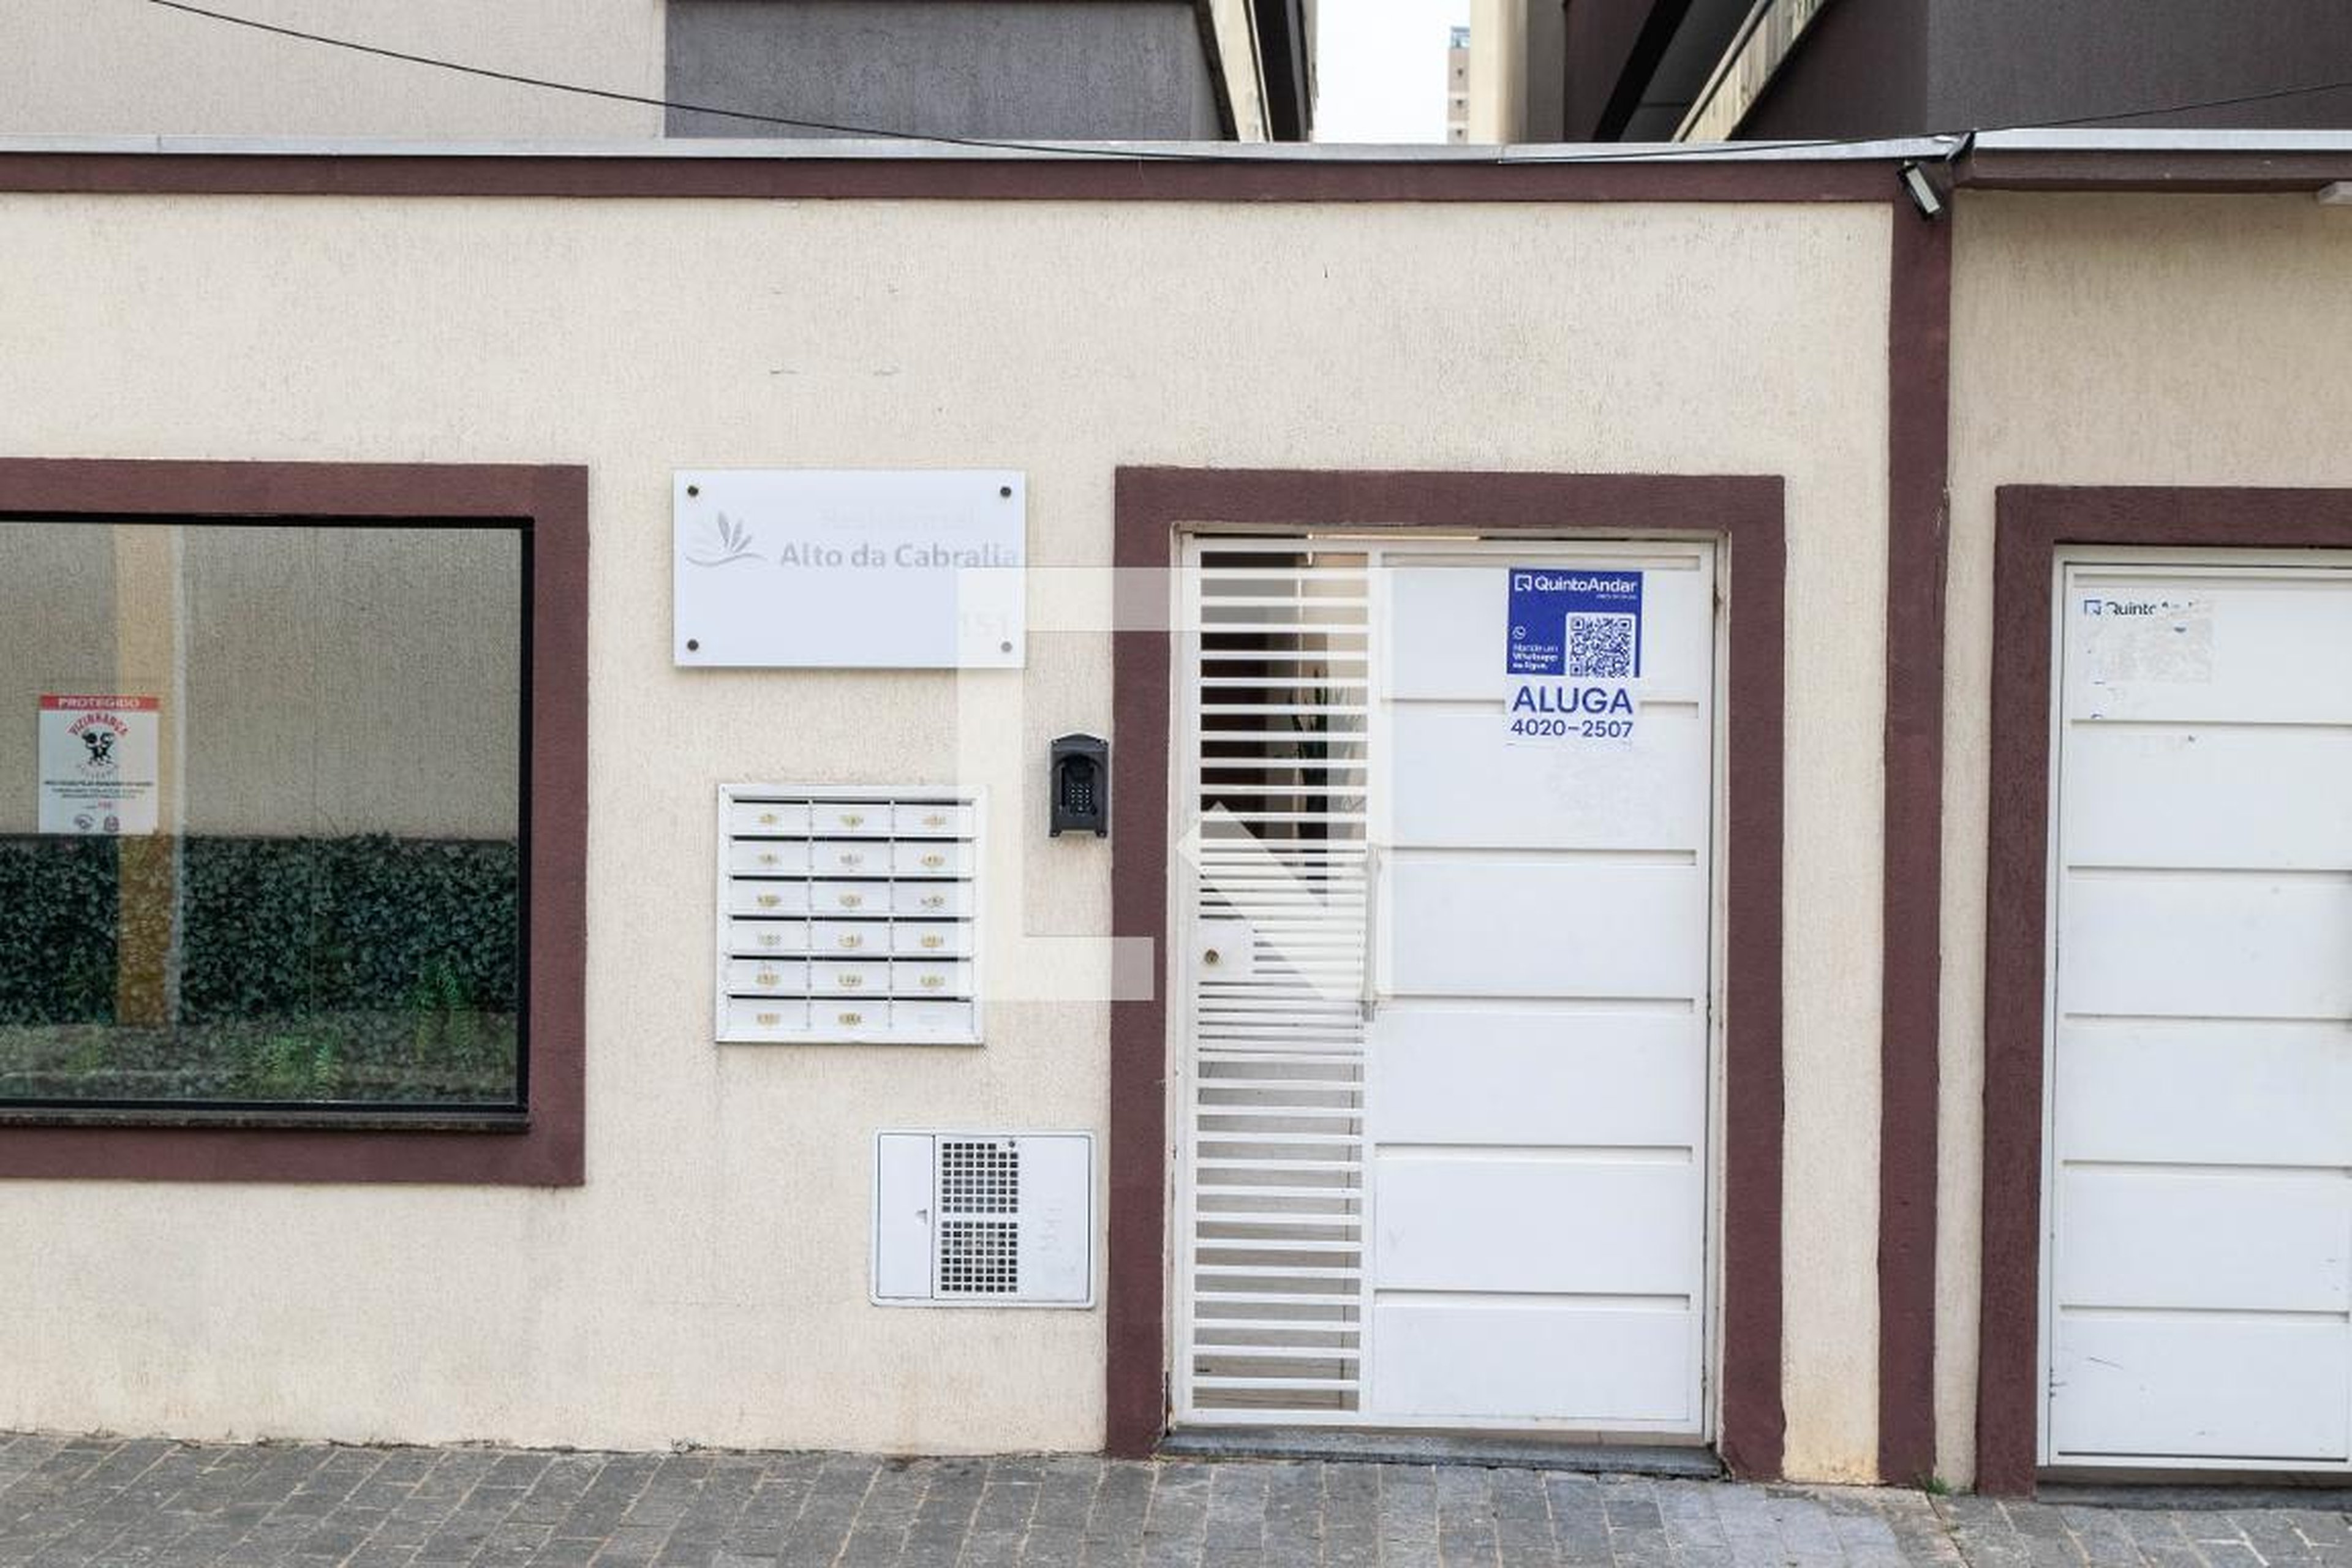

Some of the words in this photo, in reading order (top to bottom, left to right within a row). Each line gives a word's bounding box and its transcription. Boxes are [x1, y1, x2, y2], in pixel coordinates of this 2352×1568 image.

[780, 541, 843, 567] Alto
[851, 541, 886, 567] da
[1534, 576, 1637, 592] QuintoAndar
[58, 697, 140, 708] PROTEGIDO
[1512, 685, 1633, 715] ALUGA
[1510, 718, 1634, 738] 4020-2507
